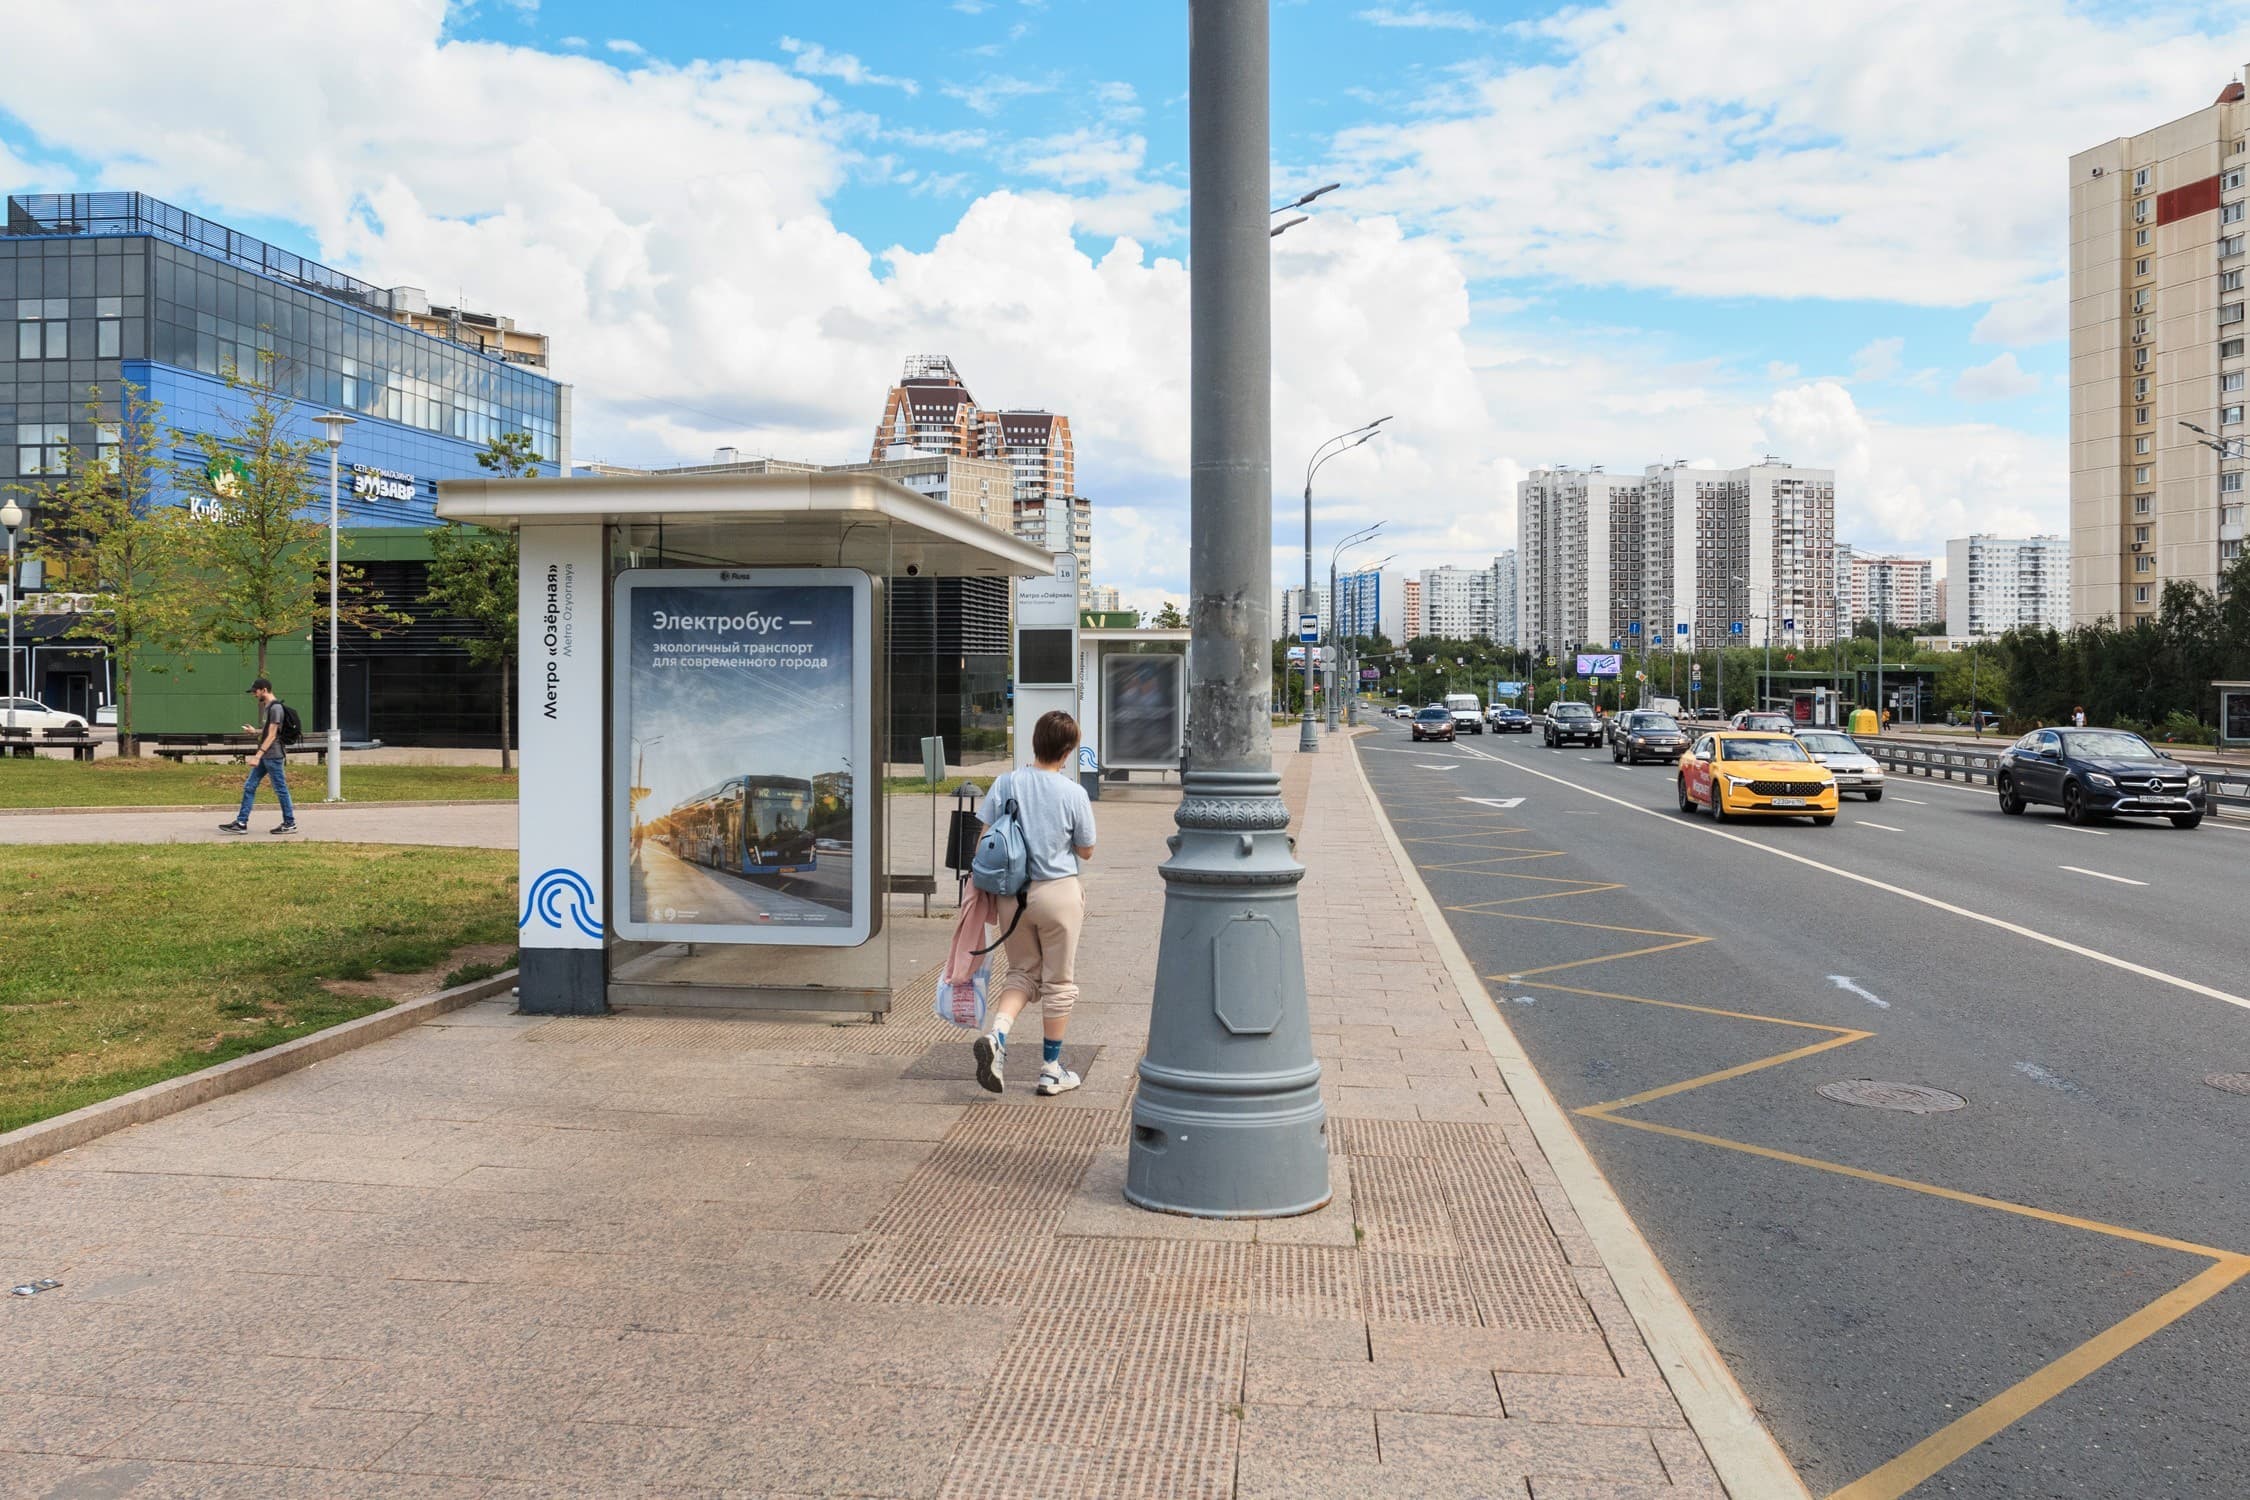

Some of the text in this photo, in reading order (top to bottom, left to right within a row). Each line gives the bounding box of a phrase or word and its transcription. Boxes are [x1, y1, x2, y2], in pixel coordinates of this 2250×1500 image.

[563, 563, 574, 657] Metro Ozyornaya
[652, 610, 783, 635] Электробус
[543, 564, 560, 719] Метро «Озёрная»
[652, 642, 814, 655] экологичный транспорт
[652, 657, 828, 669] для современного города
